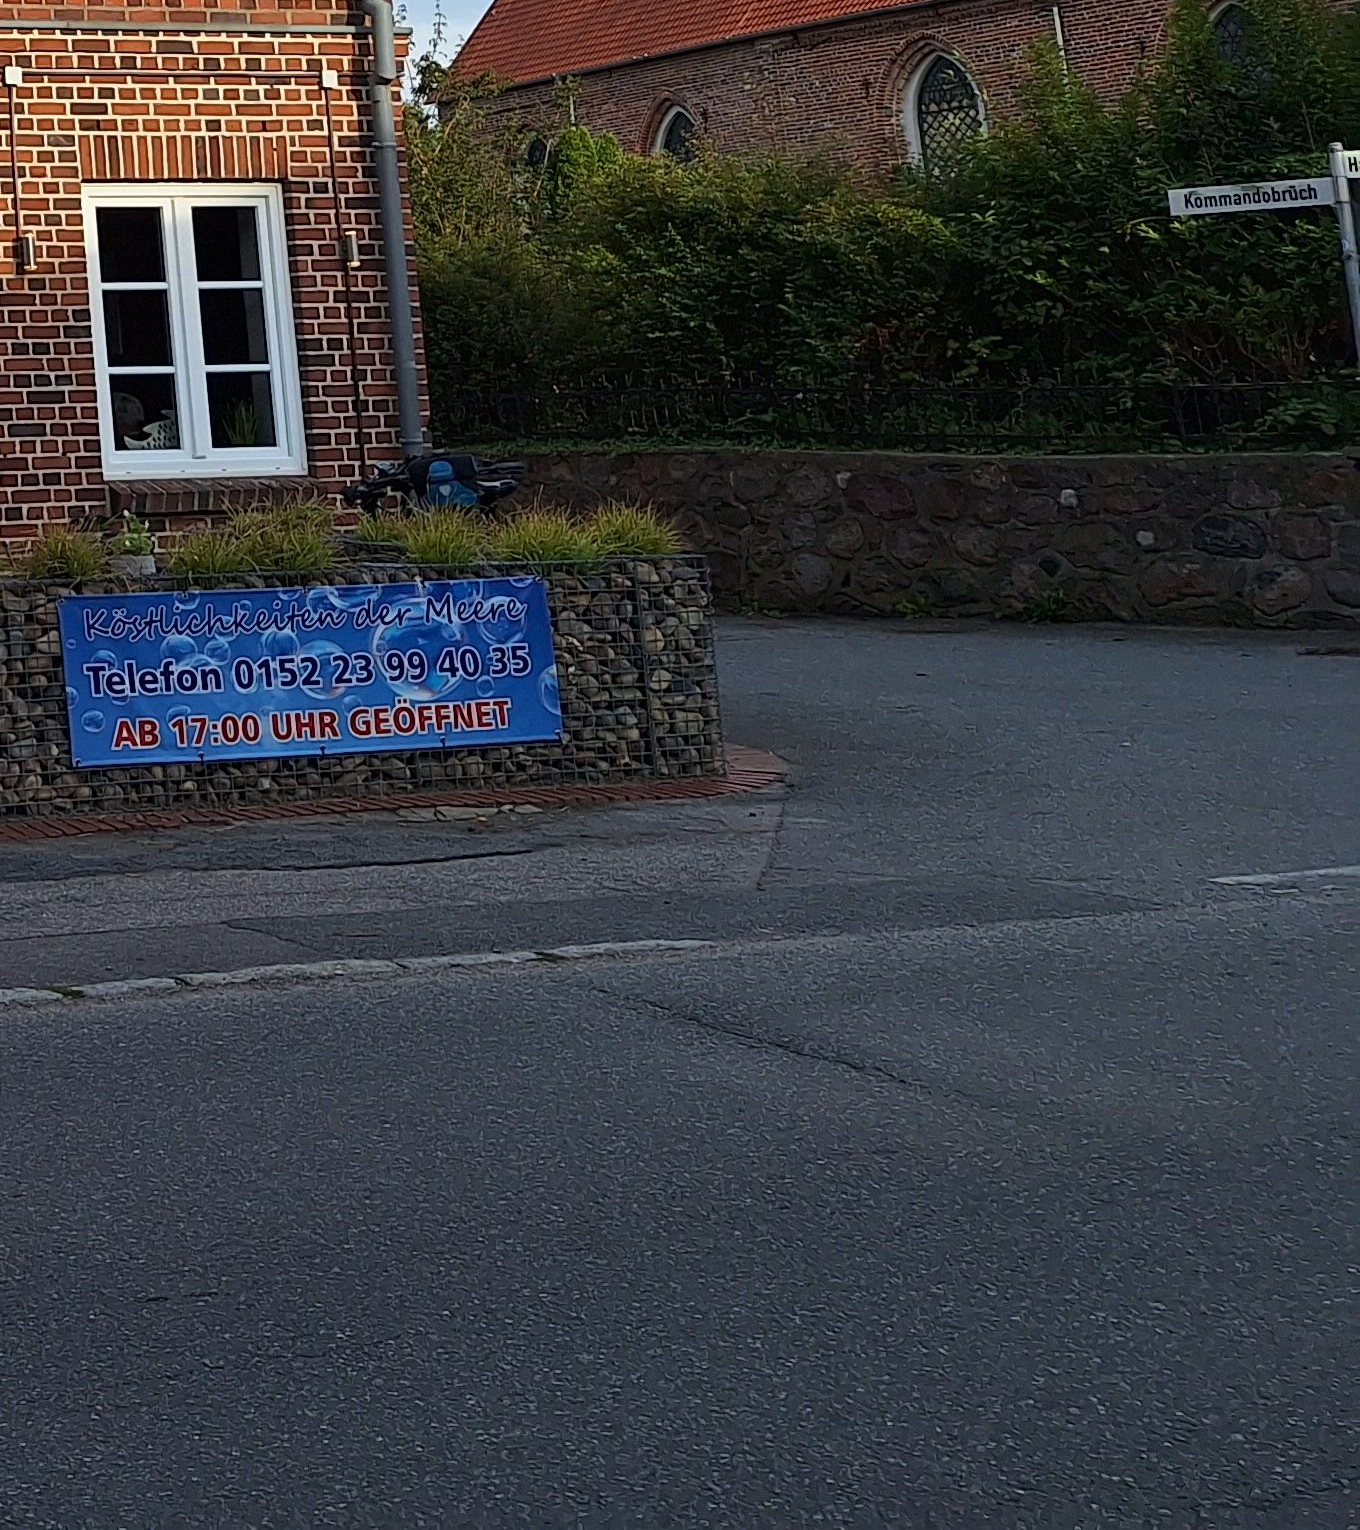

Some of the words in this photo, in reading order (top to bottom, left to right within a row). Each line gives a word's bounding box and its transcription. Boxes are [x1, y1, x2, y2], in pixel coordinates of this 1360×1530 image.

[1184, 183, 1318, 210] Kommandobrüch
[83, 599, 346, 643] Köstlichkeiten
[353, 597, 412, 630] der
[423, 592, 528, 625] Meere
[83, 657, 225, 698] Telefon
[233, 654, 322, 692] 0152
[331, 651, 375, 687] 23
[384, 648, 427, 683] 99
[436, 645, 481, 680] 40
[488, 642, 532, 677] 35
[111, 717, 161, 750] AB
[170, 713, 262, 748] 17:00
[270, 709, 343, 744] UHR
[349, 697, 512, 739] GEÖFFNET
